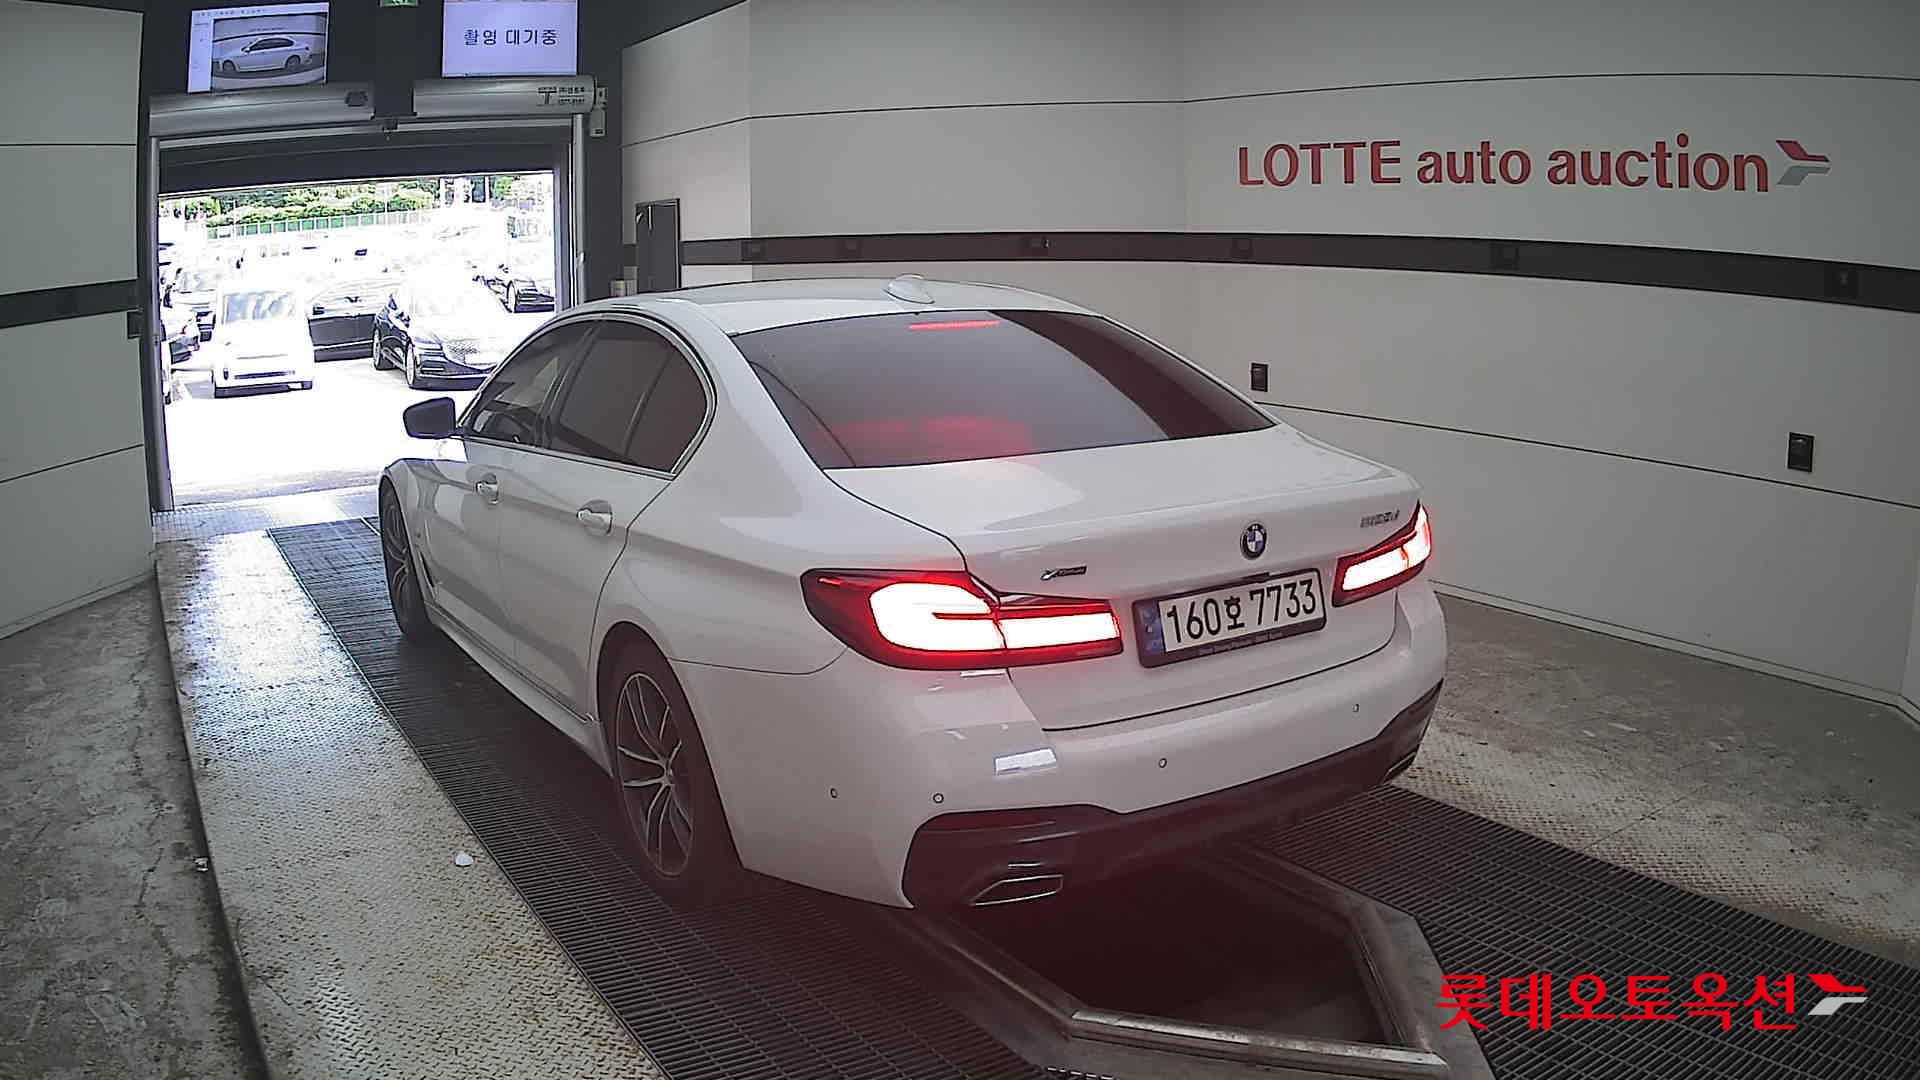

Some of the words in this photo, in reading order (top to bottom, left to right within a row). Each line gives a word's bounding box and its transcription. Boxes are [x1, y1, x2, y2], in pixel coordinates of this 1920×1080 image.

[464, 29, 497, 46] 촬영
[505, 29, 558, 46] 대기중
[1239, 140, 1401, 186] LOTTE
[1417, 141, 1532, 184] auto
[1548, 133, 1769, 191] auction
[1166, 596, 1245, 643] 160호
[1249, 578, 1316, 626] 7733
